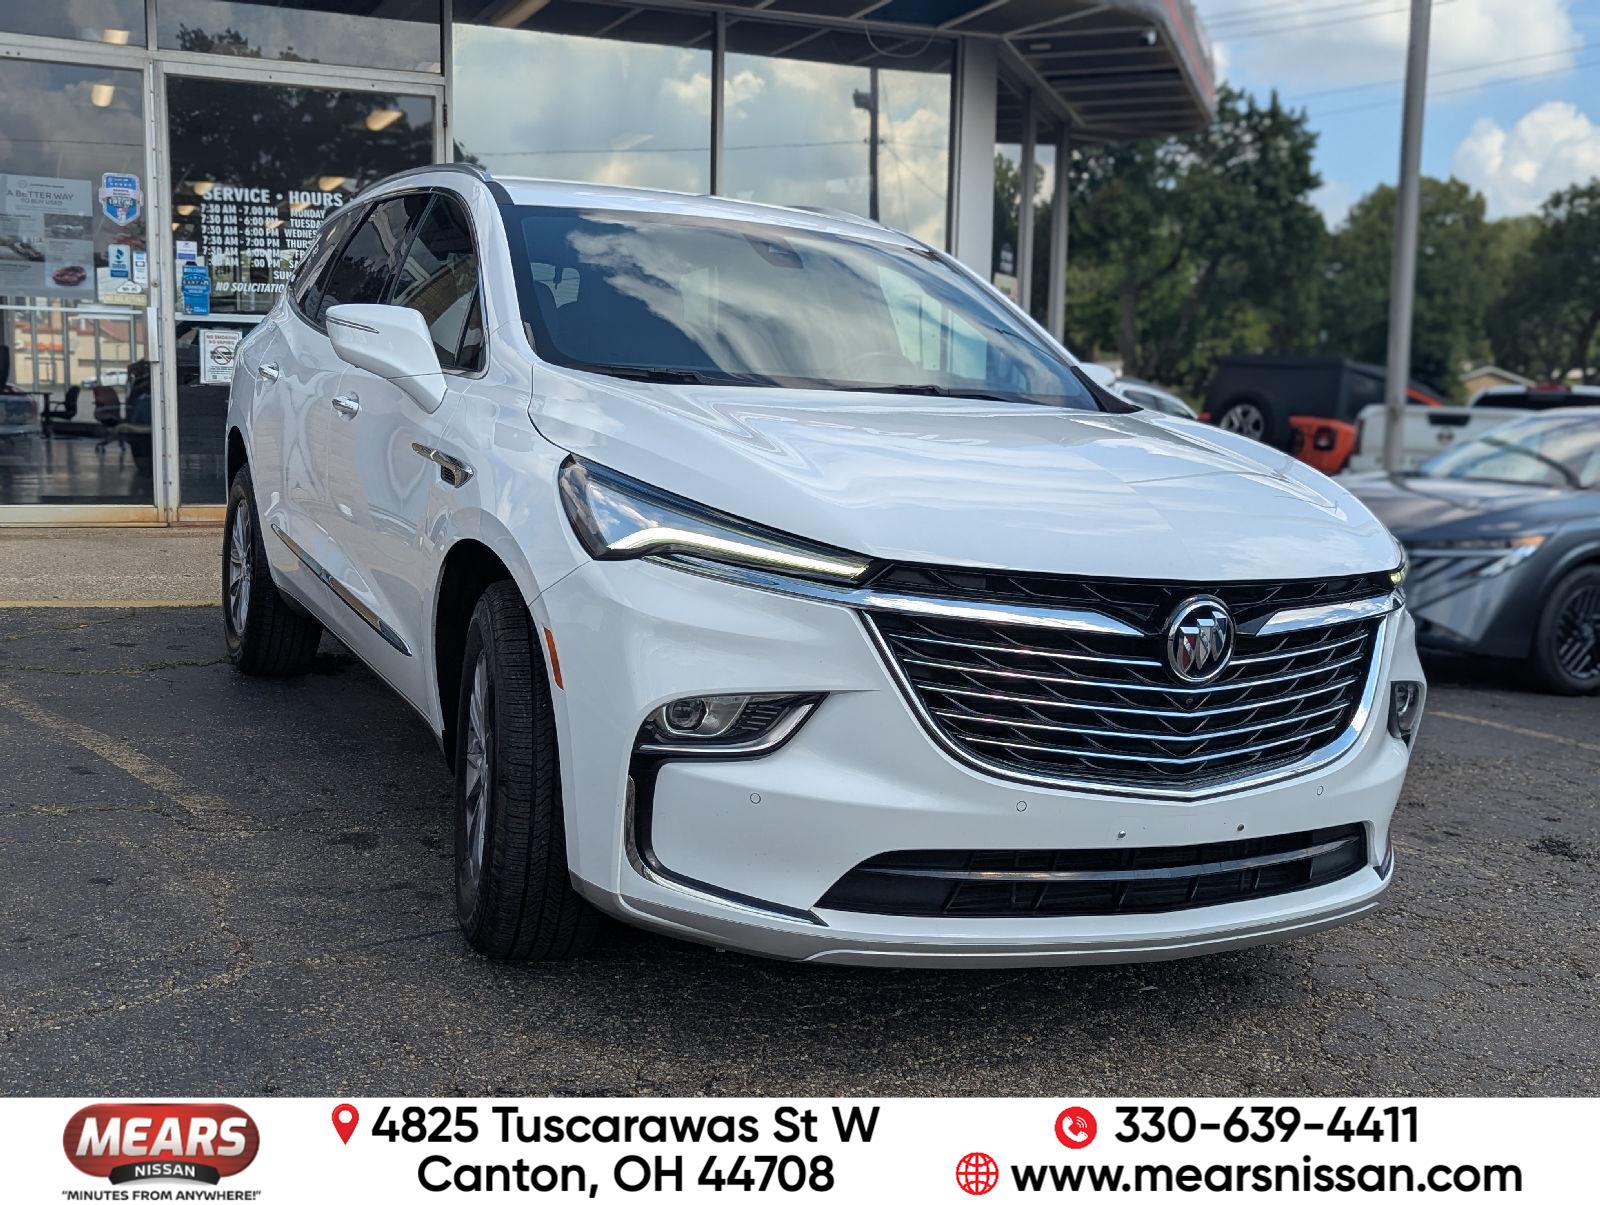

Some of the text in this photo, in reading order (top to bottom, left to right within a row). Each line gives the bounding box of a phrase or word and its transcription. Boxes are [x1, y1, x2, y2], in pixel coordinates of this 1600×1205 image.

[203, 187, 343, 206] SERVICE HOURS
[201, 204, 221, 213] 7:30
[222, 204, 236, 214] AM
[265, 207, 278, 216] PM
[290, 209, 326, 218] MONDAY
[201, 214, 221, 224] 7:30
[223, 215, 237, 224] AM
[244, 216, 263, 226] 6:00
[201, 225, 221, 235] 7:30
[224, 226, 238, 235] AM
[245, 227, 264, 236] 6:00
[266, 228, 279, 237] PM
[202, 235, 222, 245] 7:30
[224, 236, 238, 246] AM
[246, 237, 264, 246] 7:00
[267, 238, 279, 247] PM
[224, 247, 238, 256] AM
[267, 249, 279, 257] PM
[268, 259, 280, 268] PM
[215, 282, 228, 291] NO
